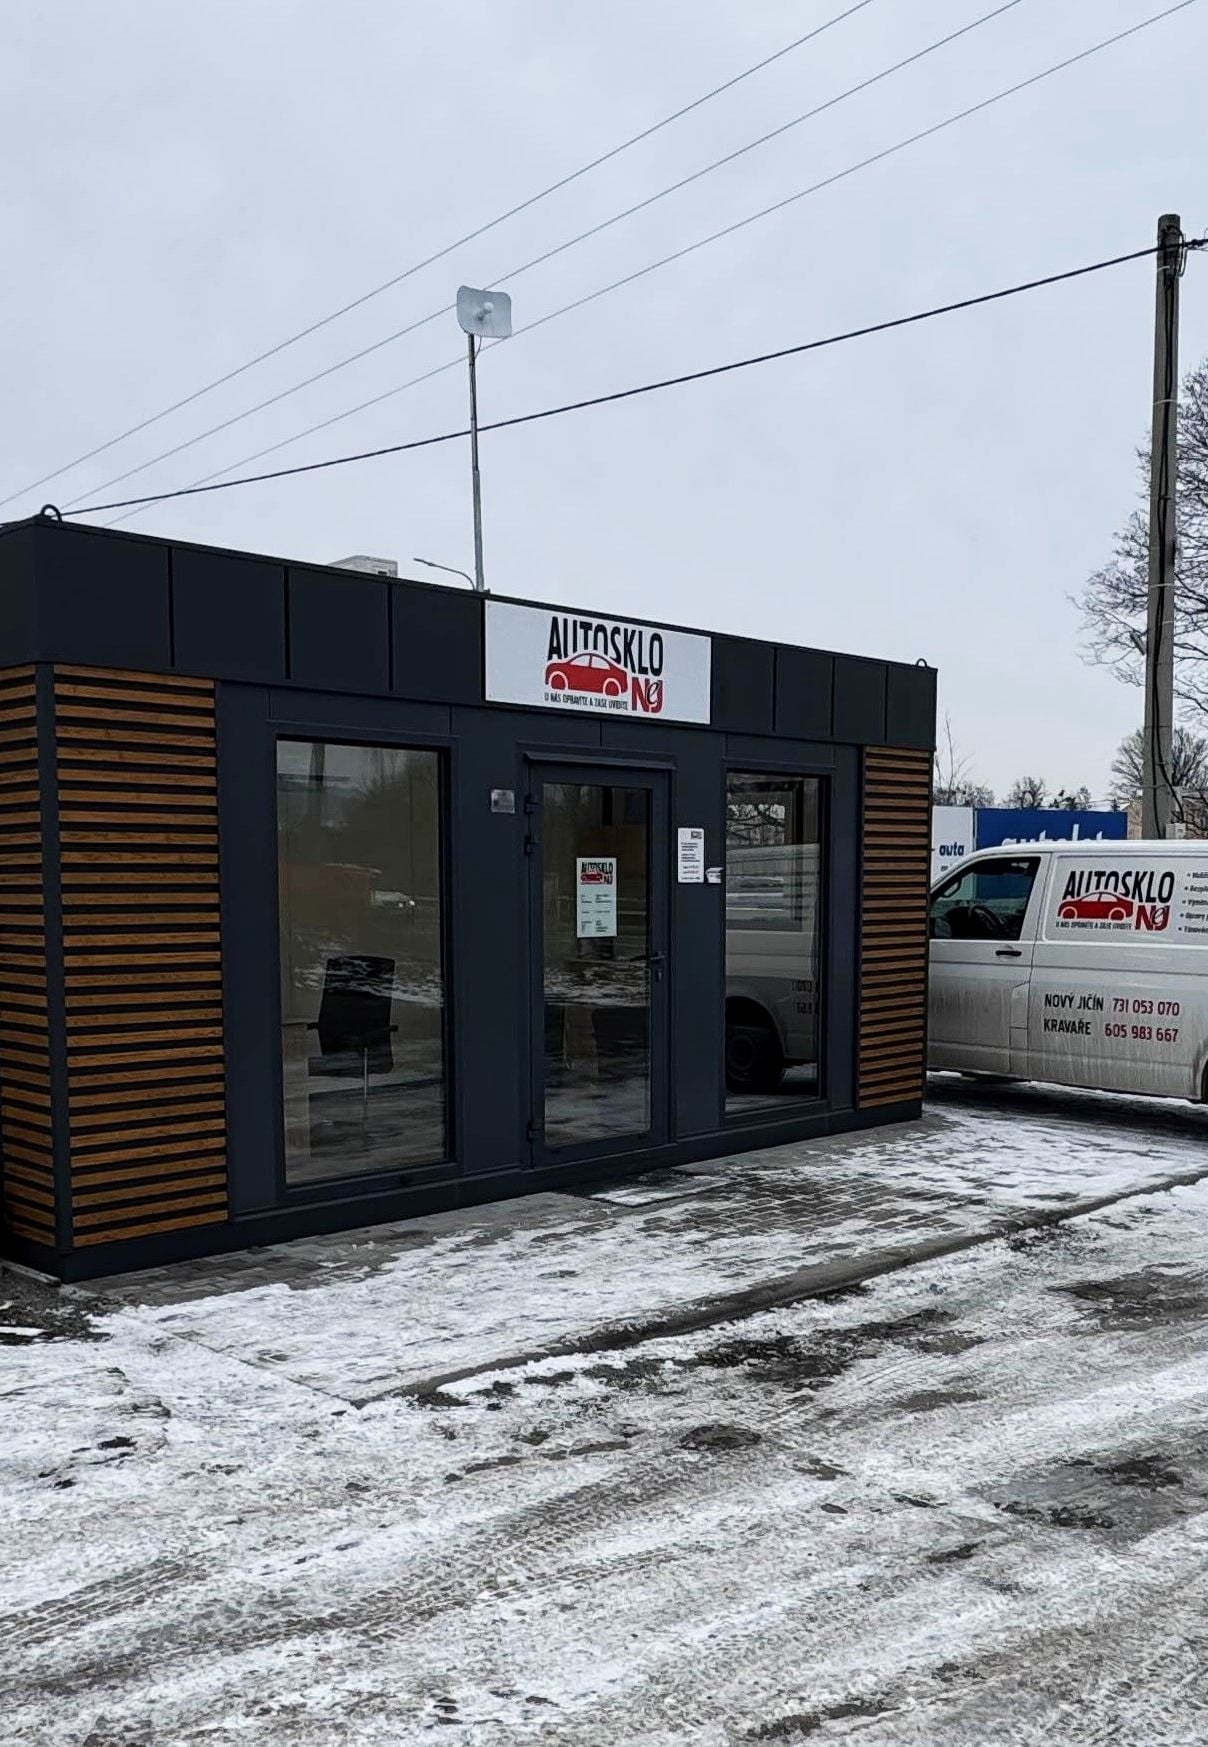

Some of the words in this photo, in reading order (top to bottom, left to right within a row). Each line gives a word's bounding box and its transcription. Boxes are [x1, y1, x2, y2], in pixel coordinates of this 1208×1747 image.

[548, 616, 664, 676] AUTOSKLO
[939, 842, 965, 857] auta
[1061, 870, 1175, 903] AUTOSKLO
[1044, 992, 1075, 1008] NOVÝ
[1077, 993, 1104, 1011] JIČÍN
[1112, 998, 1129, 1013] 731
[1132, 999, 1154, 1014] 053
[1157, 1001, 1180, 1016] 070
[1043, 1018, 1091, 1035] KRAVAŘE
[1104, 1023, 1127, 1039] 605
[1131, 1025, 1153, 1040] 983
[1156, 1028, 1179, 1042] 667
